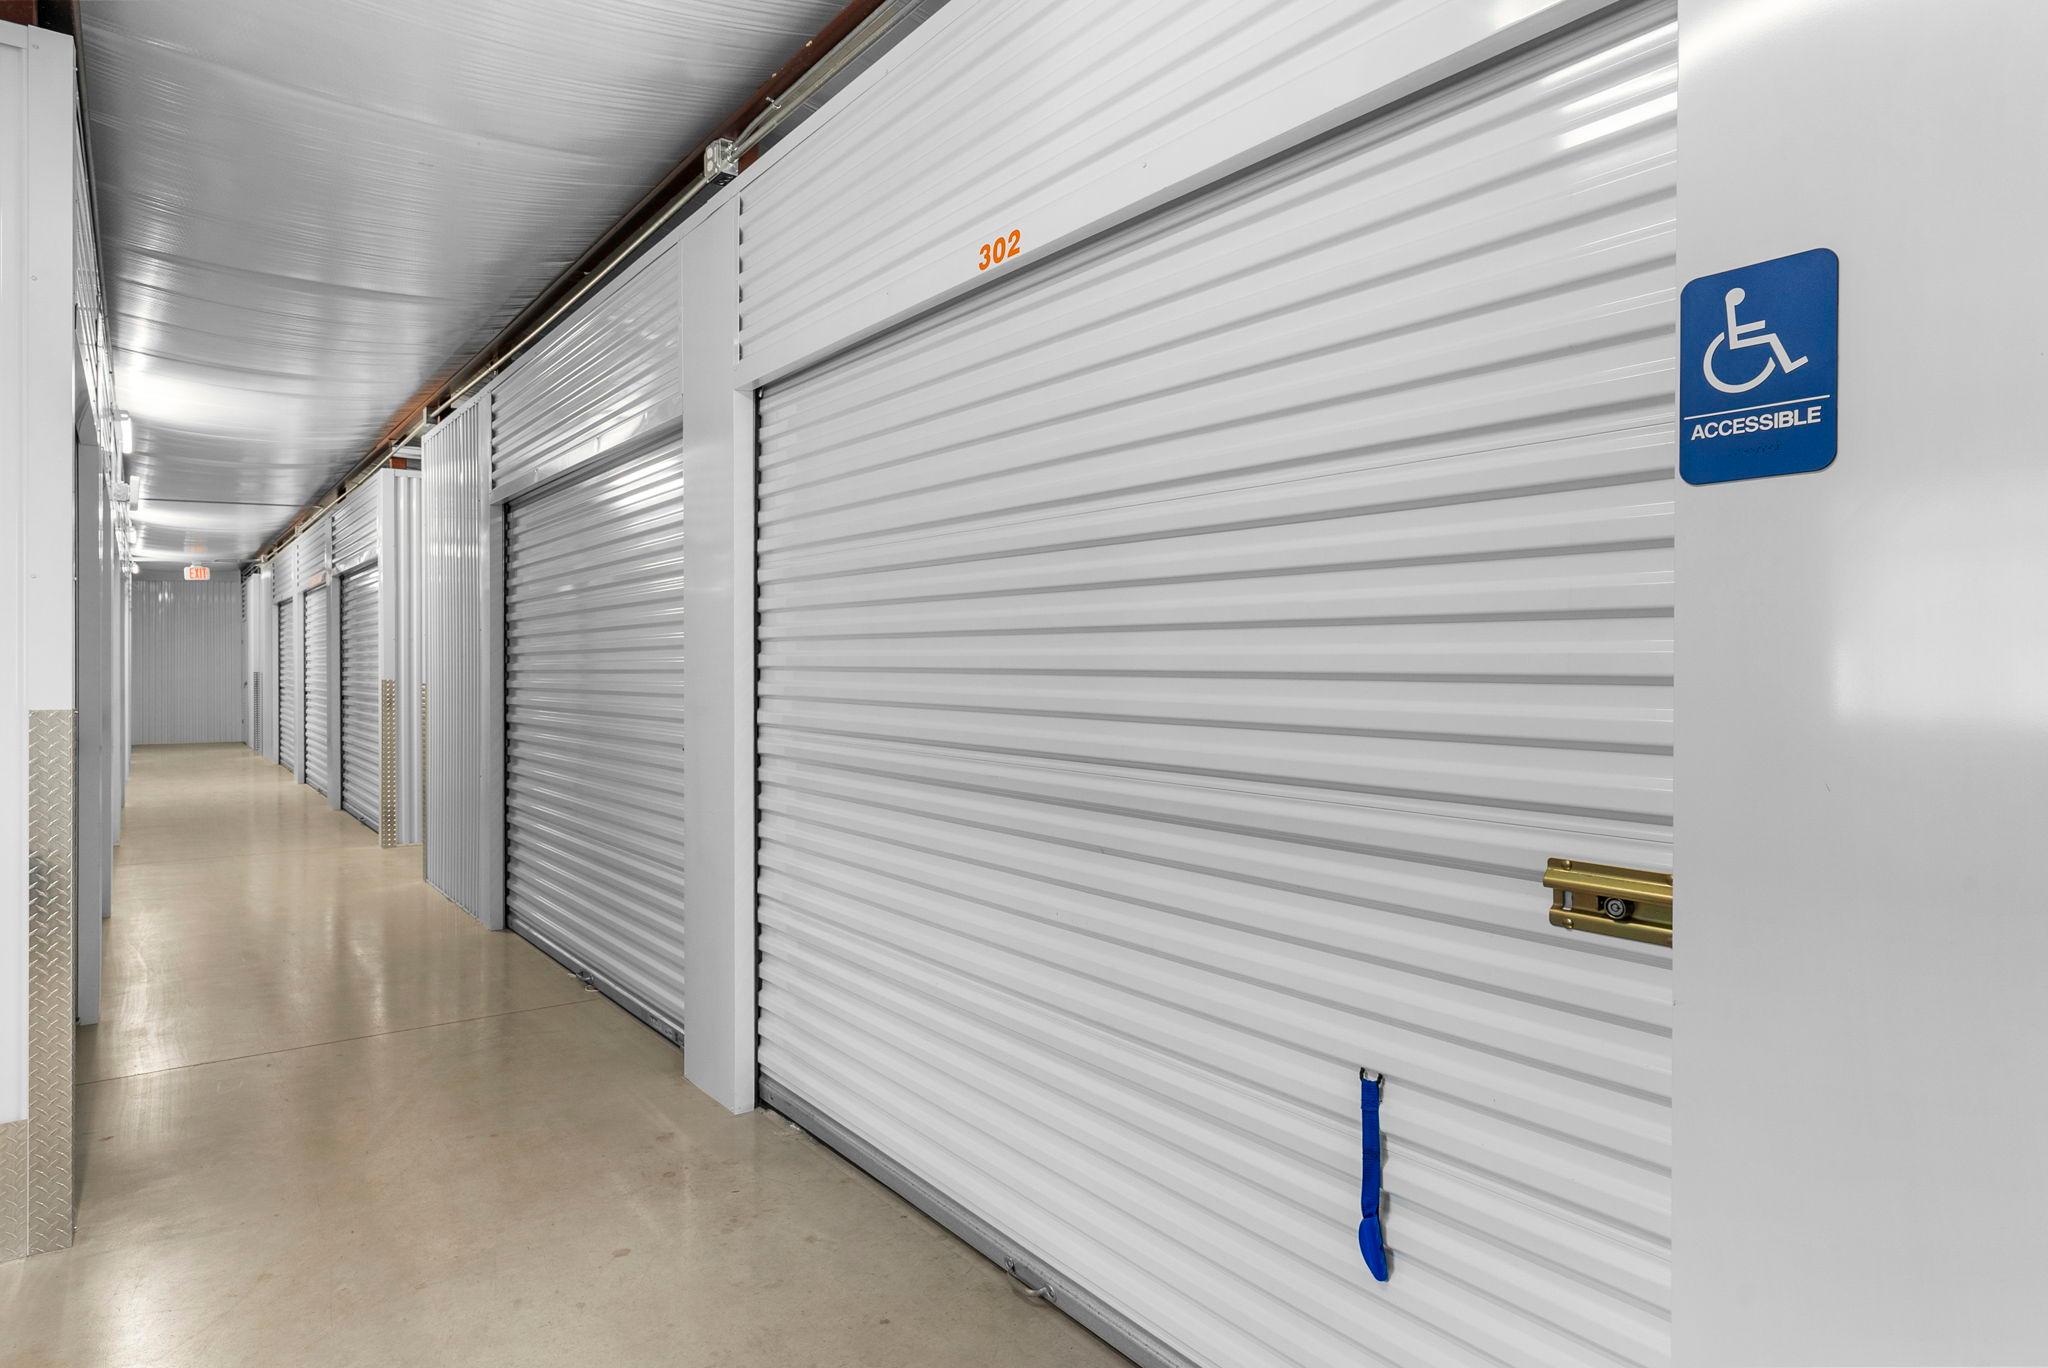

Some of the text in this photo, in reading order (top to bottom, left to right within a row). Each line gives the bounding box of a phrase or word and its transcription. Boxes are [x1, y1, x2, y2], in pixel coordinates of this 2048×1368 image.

[979, 229, 1021, 271] 302
[1690, 405, 1822, 441] ACCESSIBLE
[189, 567, 208, 579] EXIT
